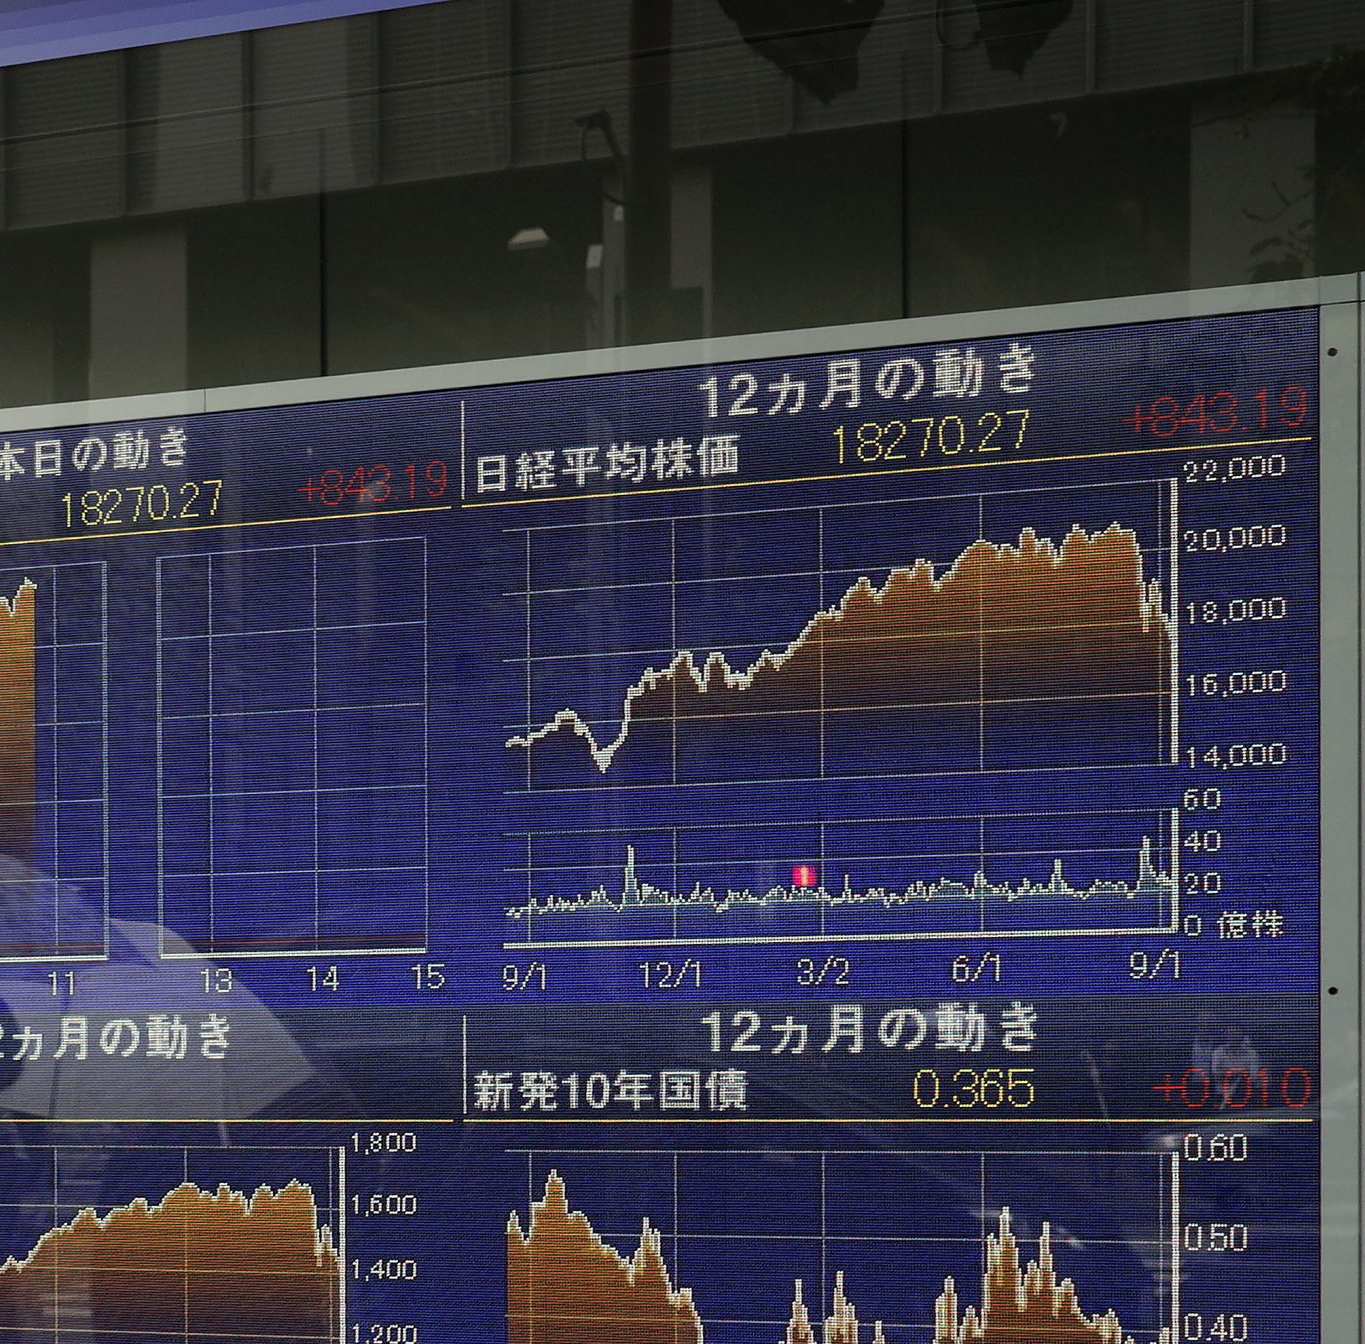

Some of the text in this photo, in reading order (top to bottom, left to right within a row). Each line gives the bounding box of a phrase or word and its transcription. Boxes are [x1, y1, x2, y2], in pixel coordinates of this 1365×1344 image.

[477, 386, 1307, 493] 日経平均株価 18270.27 +843.19
[1182, 454, 1286, 484] 22,000
[62, 478, 223, 528] 18270.27
[297, 460, 448, 506] +843.19
[1184, 524, 1286, 554] 20,000
[1185, 597, 1287, 625] 18,000
[1186, 670, 1287, 698] 16,000
[1186, 743, 1287, 771] 14,000
[1183, 788, 1221, 810] 60
[1183, 830, 1221, 852] 40
[1185, 872, 1221, 894] 20
[1183, 915, 1201, 936] 0
[48, 972, 76, 996] 11
[200, 968, 233, 993] 13
[307, 966, 340, 991] 14
[411, 964, 445, 989] 15
[502, 949, 1180, 991] 9/1 12/1 3/2 6/1 9/1
[473, 1067, 1312, 1112] 新発10年国債 0.365 +0.010
[351, 1132, 417, 1156] 1,800
[1183, 1133, 1248, 1162] 0.60
[351, 1195, 418, 1217] 1,600
[1184, 1223, 1248, 1252] 0.50
[351, 1260, 418, 1282] 1,400
[1184, 1313, 1248, 1342] 0.40
